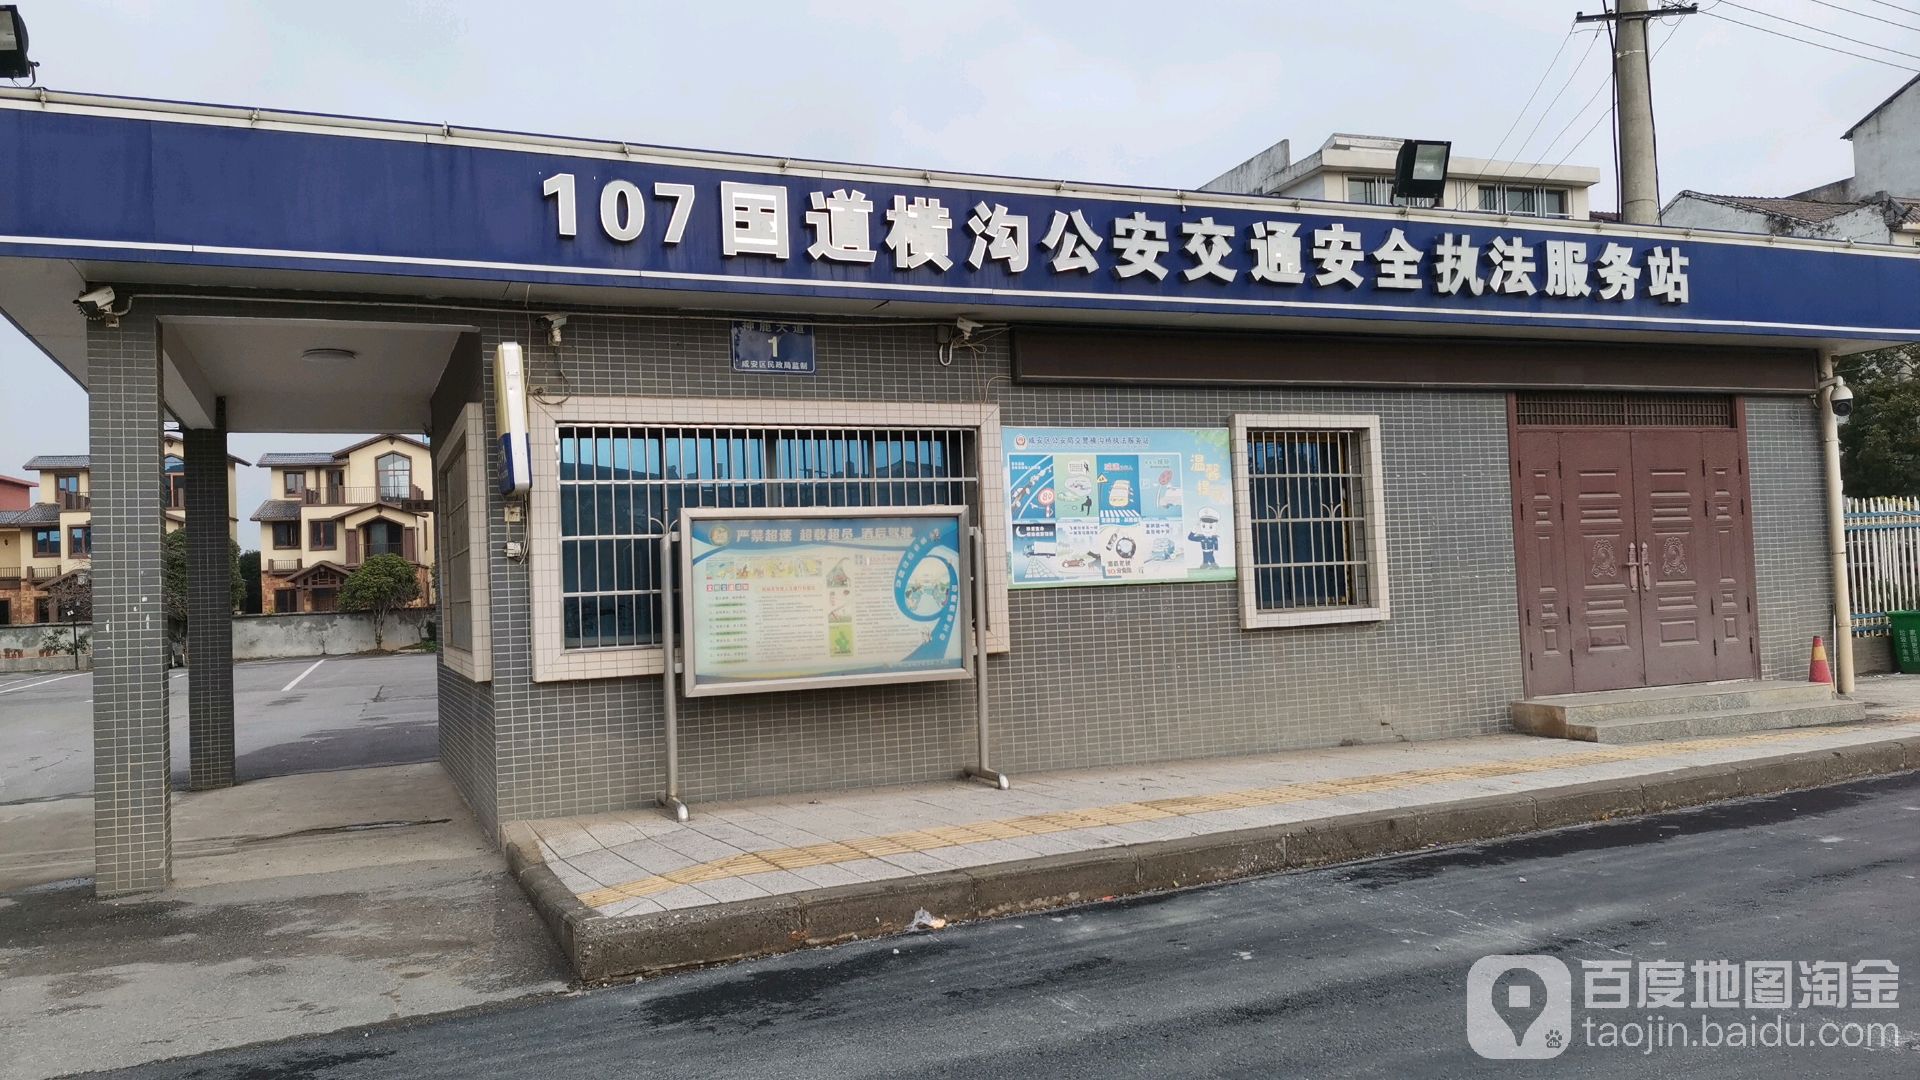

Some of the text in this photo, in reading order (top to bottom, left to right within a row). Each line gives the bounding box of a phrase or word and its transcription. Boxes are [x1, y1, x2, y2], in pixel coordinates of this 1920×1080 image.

[542, 172, 1690, 304] 107国道横沟公安交通安全执法服务站
[767, 336, 778, 358] 1
[741, 360, 808, 370] 咸安区民政局监制
[736, 526, 914, 543] 严禁超速 超载超员 酒后驾驶
